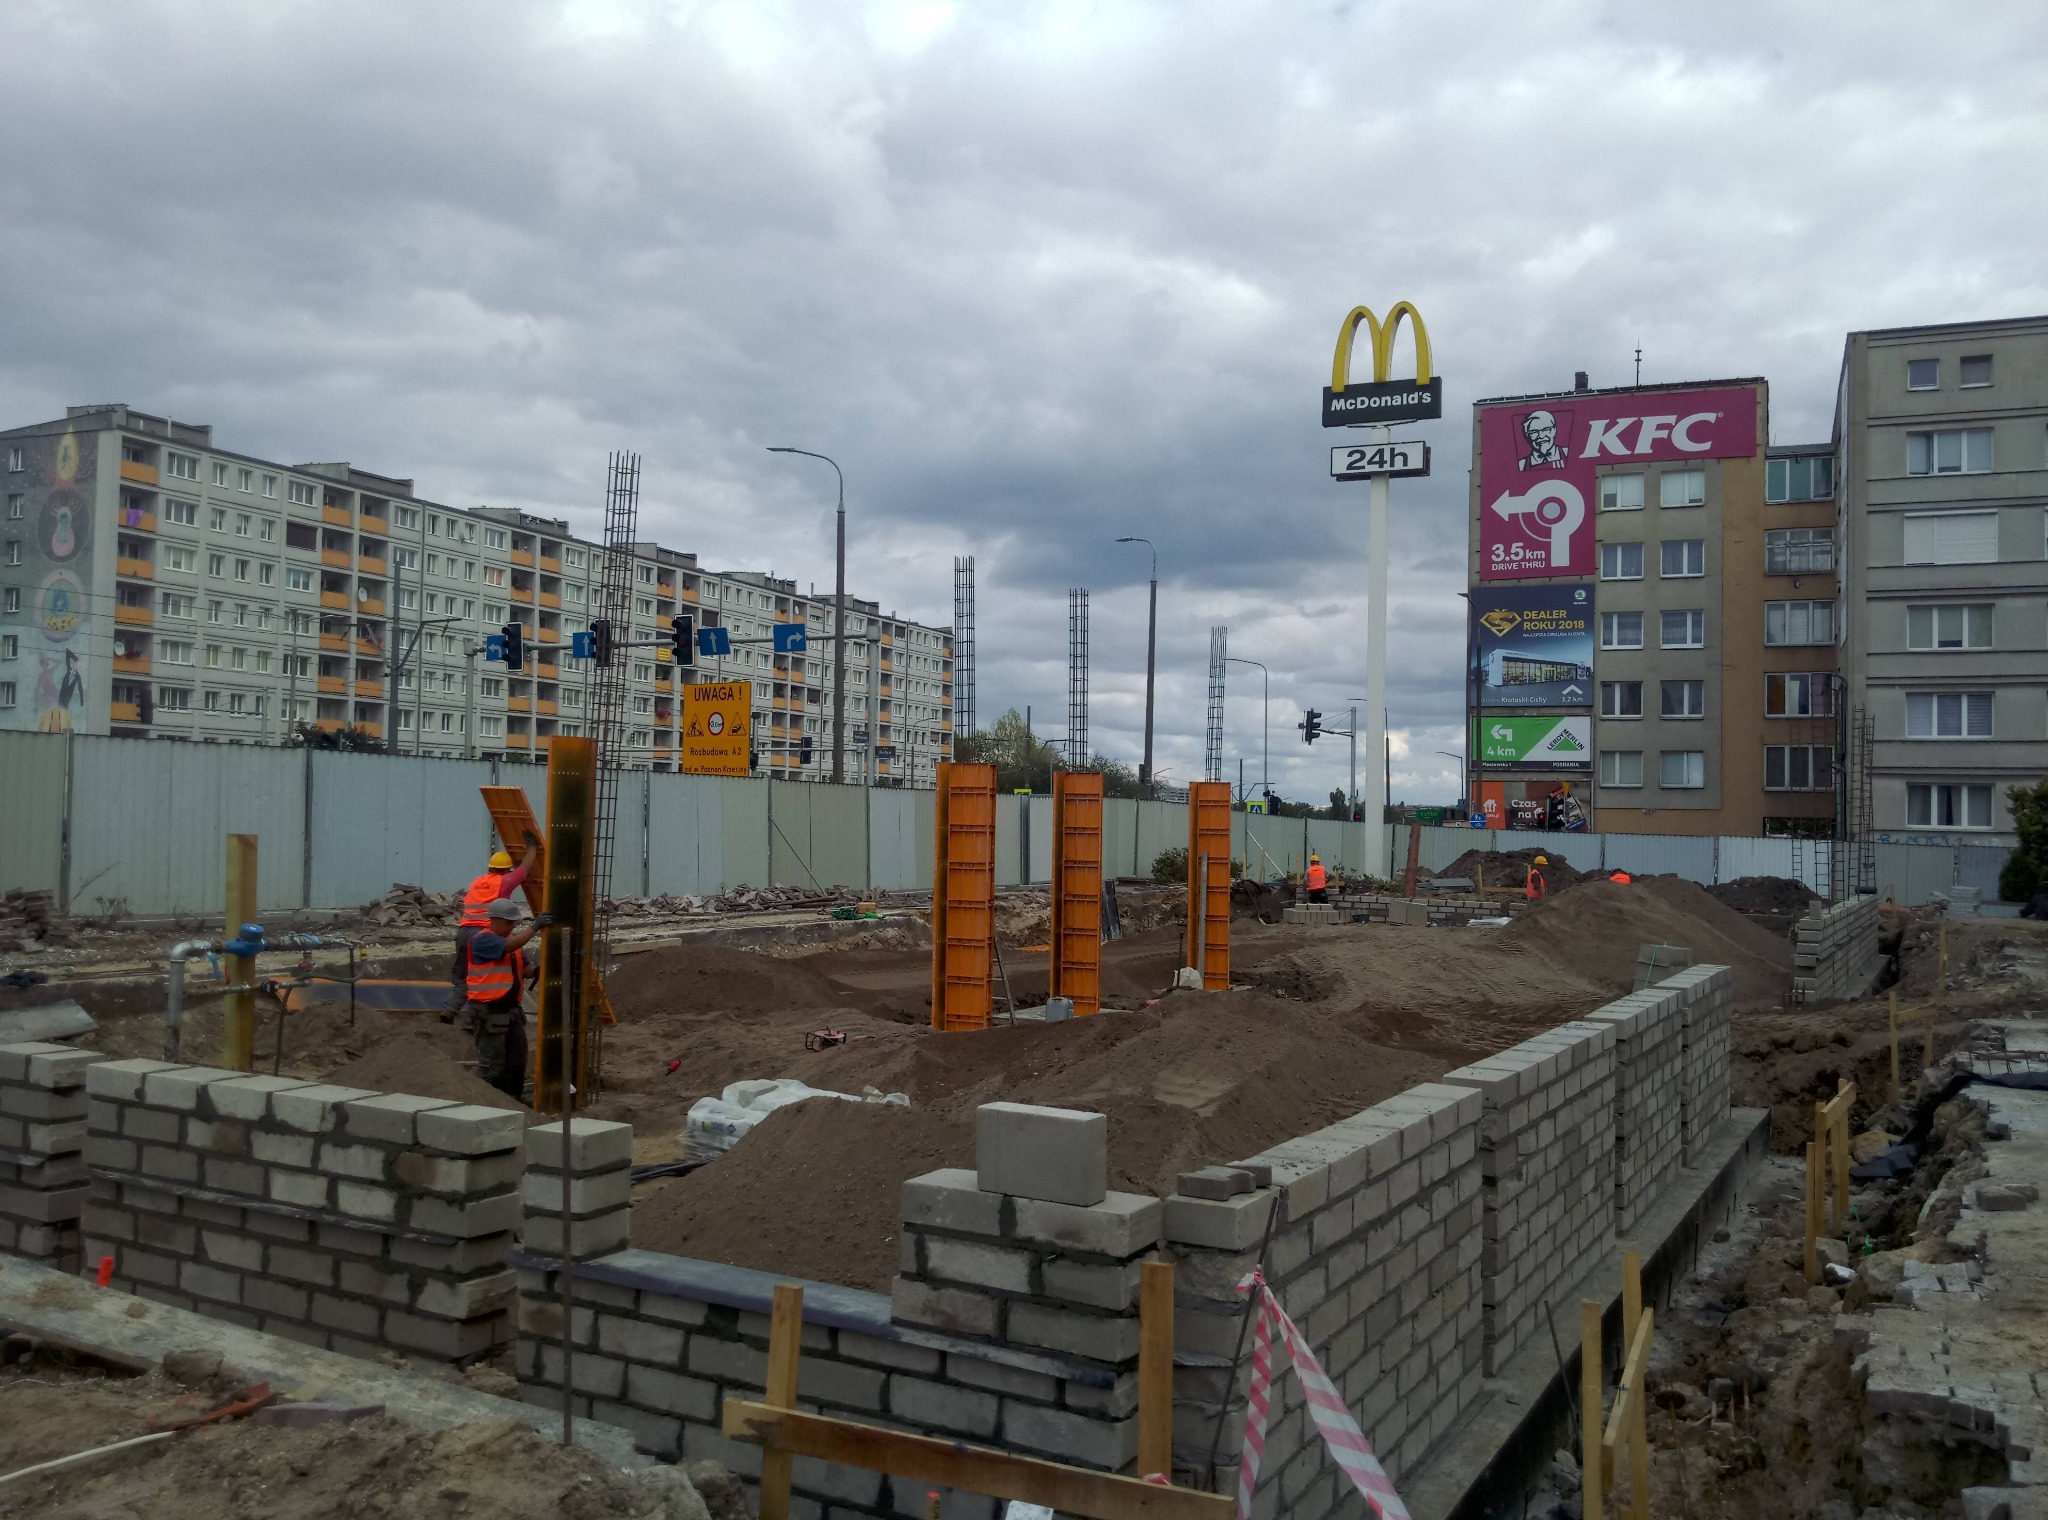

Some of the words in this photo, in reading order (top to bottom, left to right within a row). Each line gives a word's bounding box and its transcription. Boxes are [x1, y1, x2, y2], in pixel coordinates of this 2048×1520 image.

[1331, 391, 1432, 411] McDonald's
[1578, 412, 1718, 458] KFC
[1346, 447, 1409, 470] 24h
[1491, 542, 1524, 562] 3.5
[1525, 549, 1546, 560] km
[1491, 562, 1519, 571] DRIVE
[1520, 560, 1545, 569] THRU
[1523, 610, 1567, 620] DEALER
[1523, 621, 1556, 630] ROKU
[1558, 620, 1585, 629] 2018
[694, 686, 735, 702] UWAGA
[1546, 732, 1565, 751] LEROY
[1562, 728, 1585, 751] MERLIN
[690, 747, 728, 756] Rozbudowa
[1486, 746, 1495, 756] 4
[1497, 745, 1516, 756] km
[1511, 799, 1537, 808] Czas
[1517, 810, 1532, 819] na
